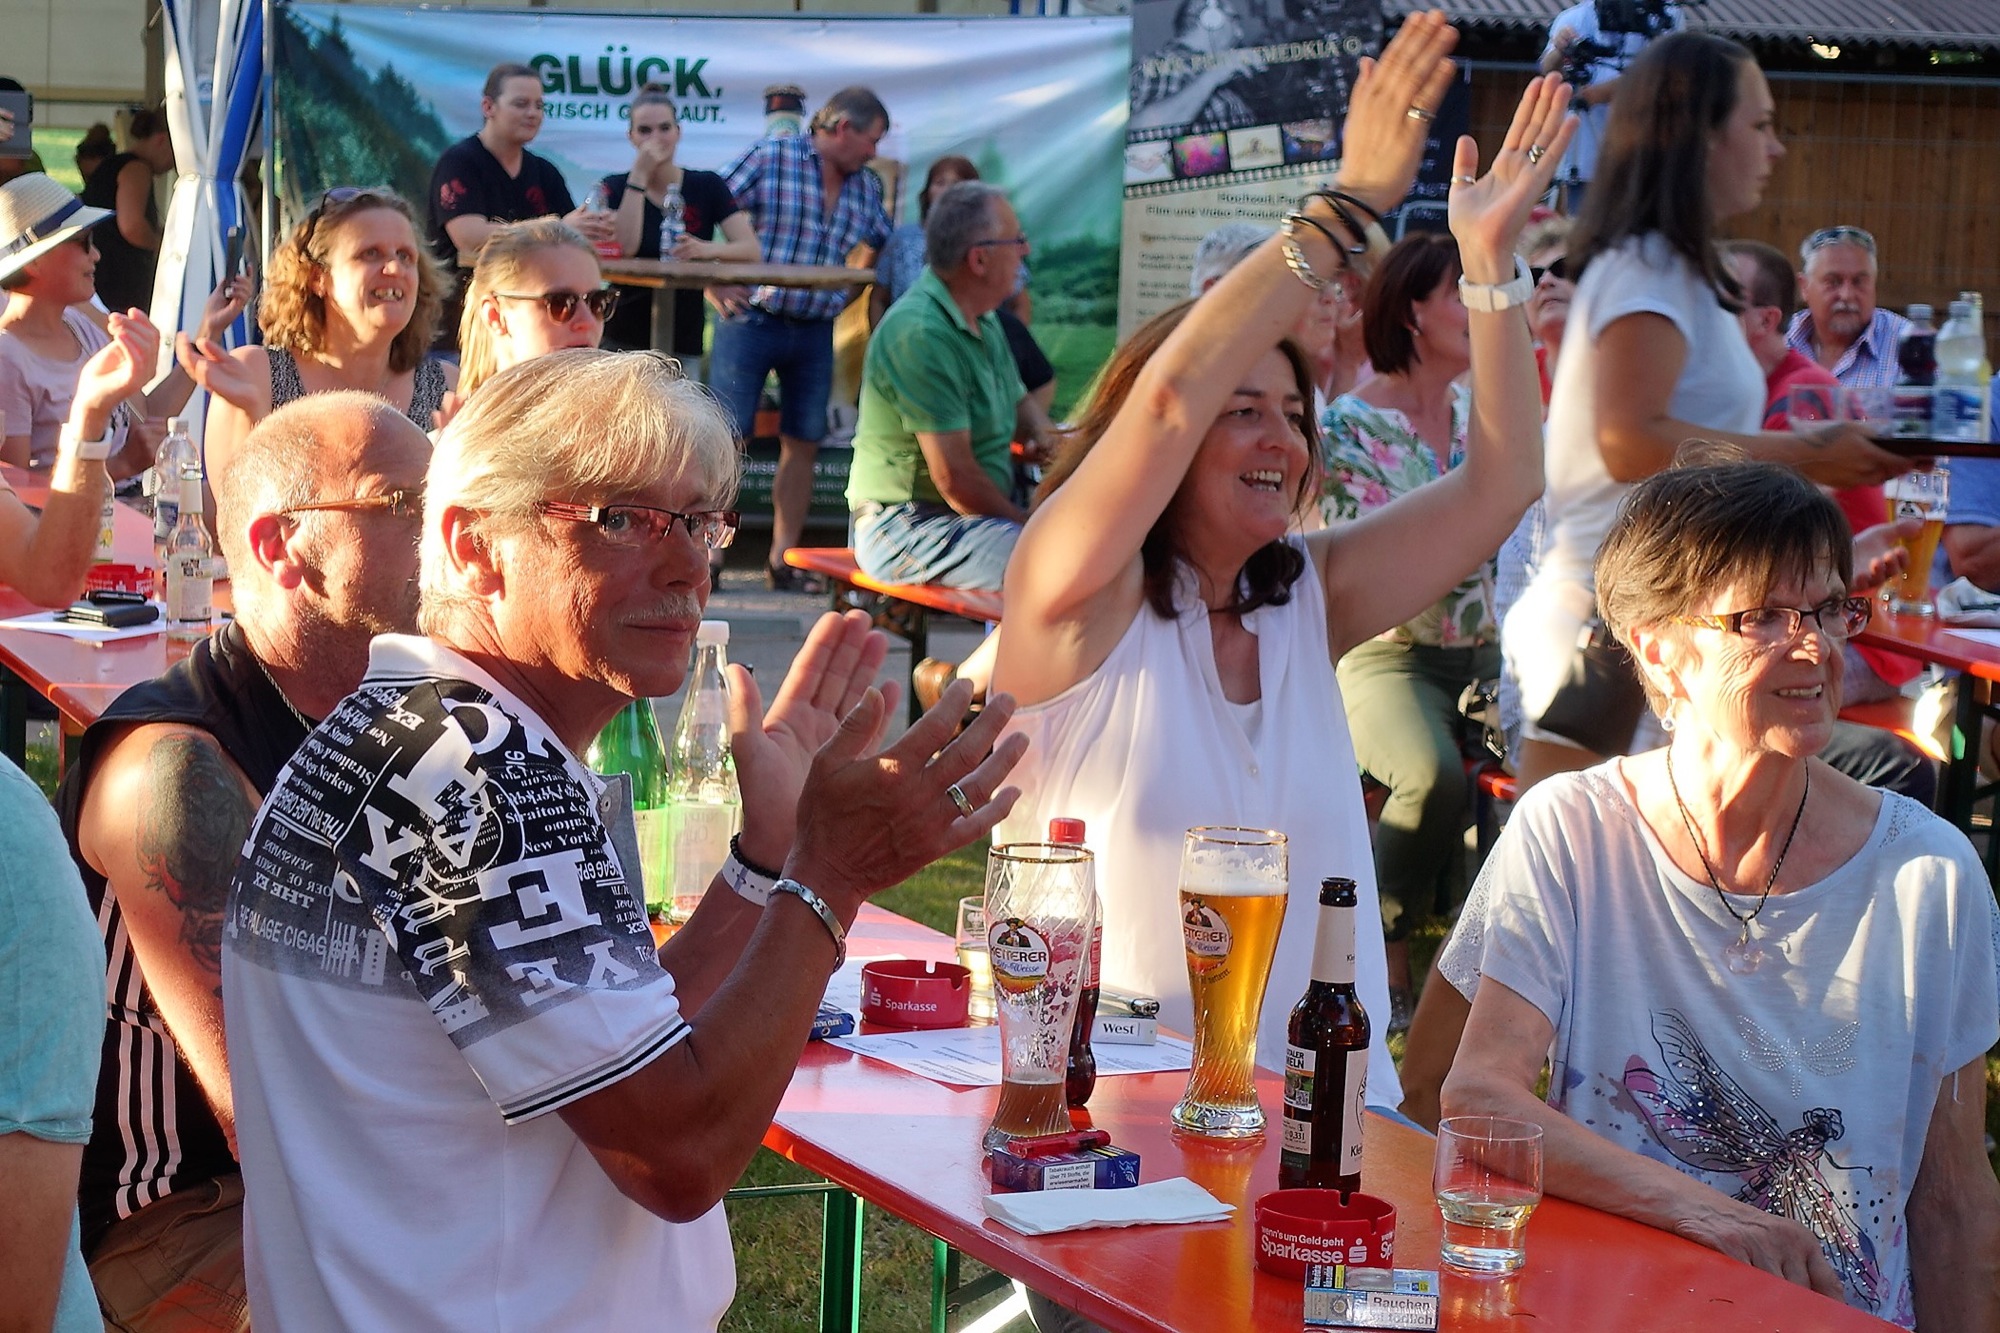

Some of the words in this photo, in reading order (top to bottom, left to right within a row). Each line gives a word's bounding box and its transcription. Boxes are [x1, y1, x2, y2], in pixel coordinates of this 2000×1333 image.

[543, 103, 608, 119] RISCH
[885, 998, 938, 1013] Sparkasse
[1103, 1022, 1135, 1035] West
[1298, 1234, 1322, 1246] Geld
[1322, 1237, 1344, 1248] geht
[1261, 1235, 1344, 1264] Sparkasse
[1373, 1297, 1431, 1310] Rauchen
